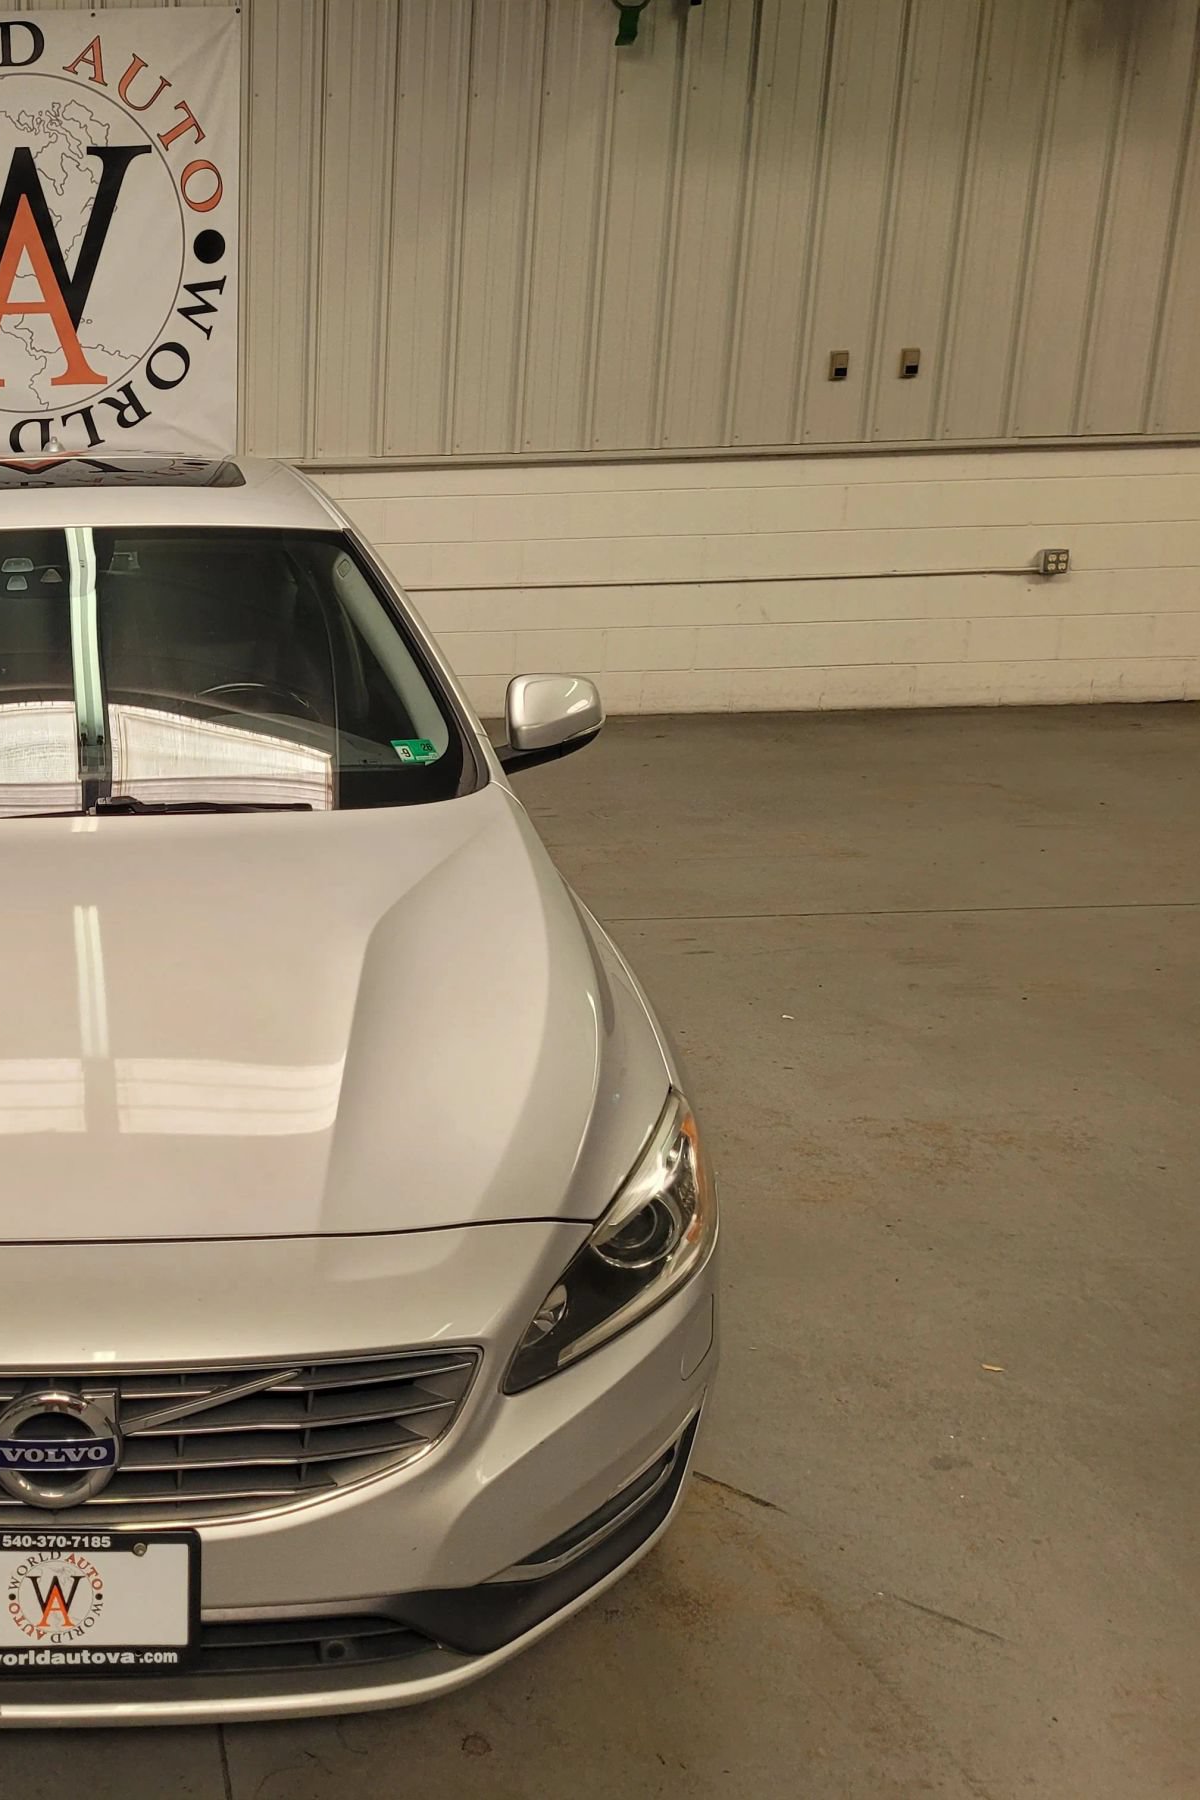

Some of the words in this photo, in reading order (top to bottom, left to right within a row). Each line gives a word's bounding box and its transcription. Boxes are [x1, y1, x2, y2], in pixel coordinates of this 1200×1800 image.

[62, 35, 223, 213] AUTO
[9, 275, 228, 453] WORLD
[2, 1535, 111, 1548] 540-370-7185
[8, 1551, 62, 1590] WORLD
[64, 1552, 103, 1590] AUTO
[8, 1602, 47, 1641] AUTO
[50, 1602, 104, 1643] WORLD
